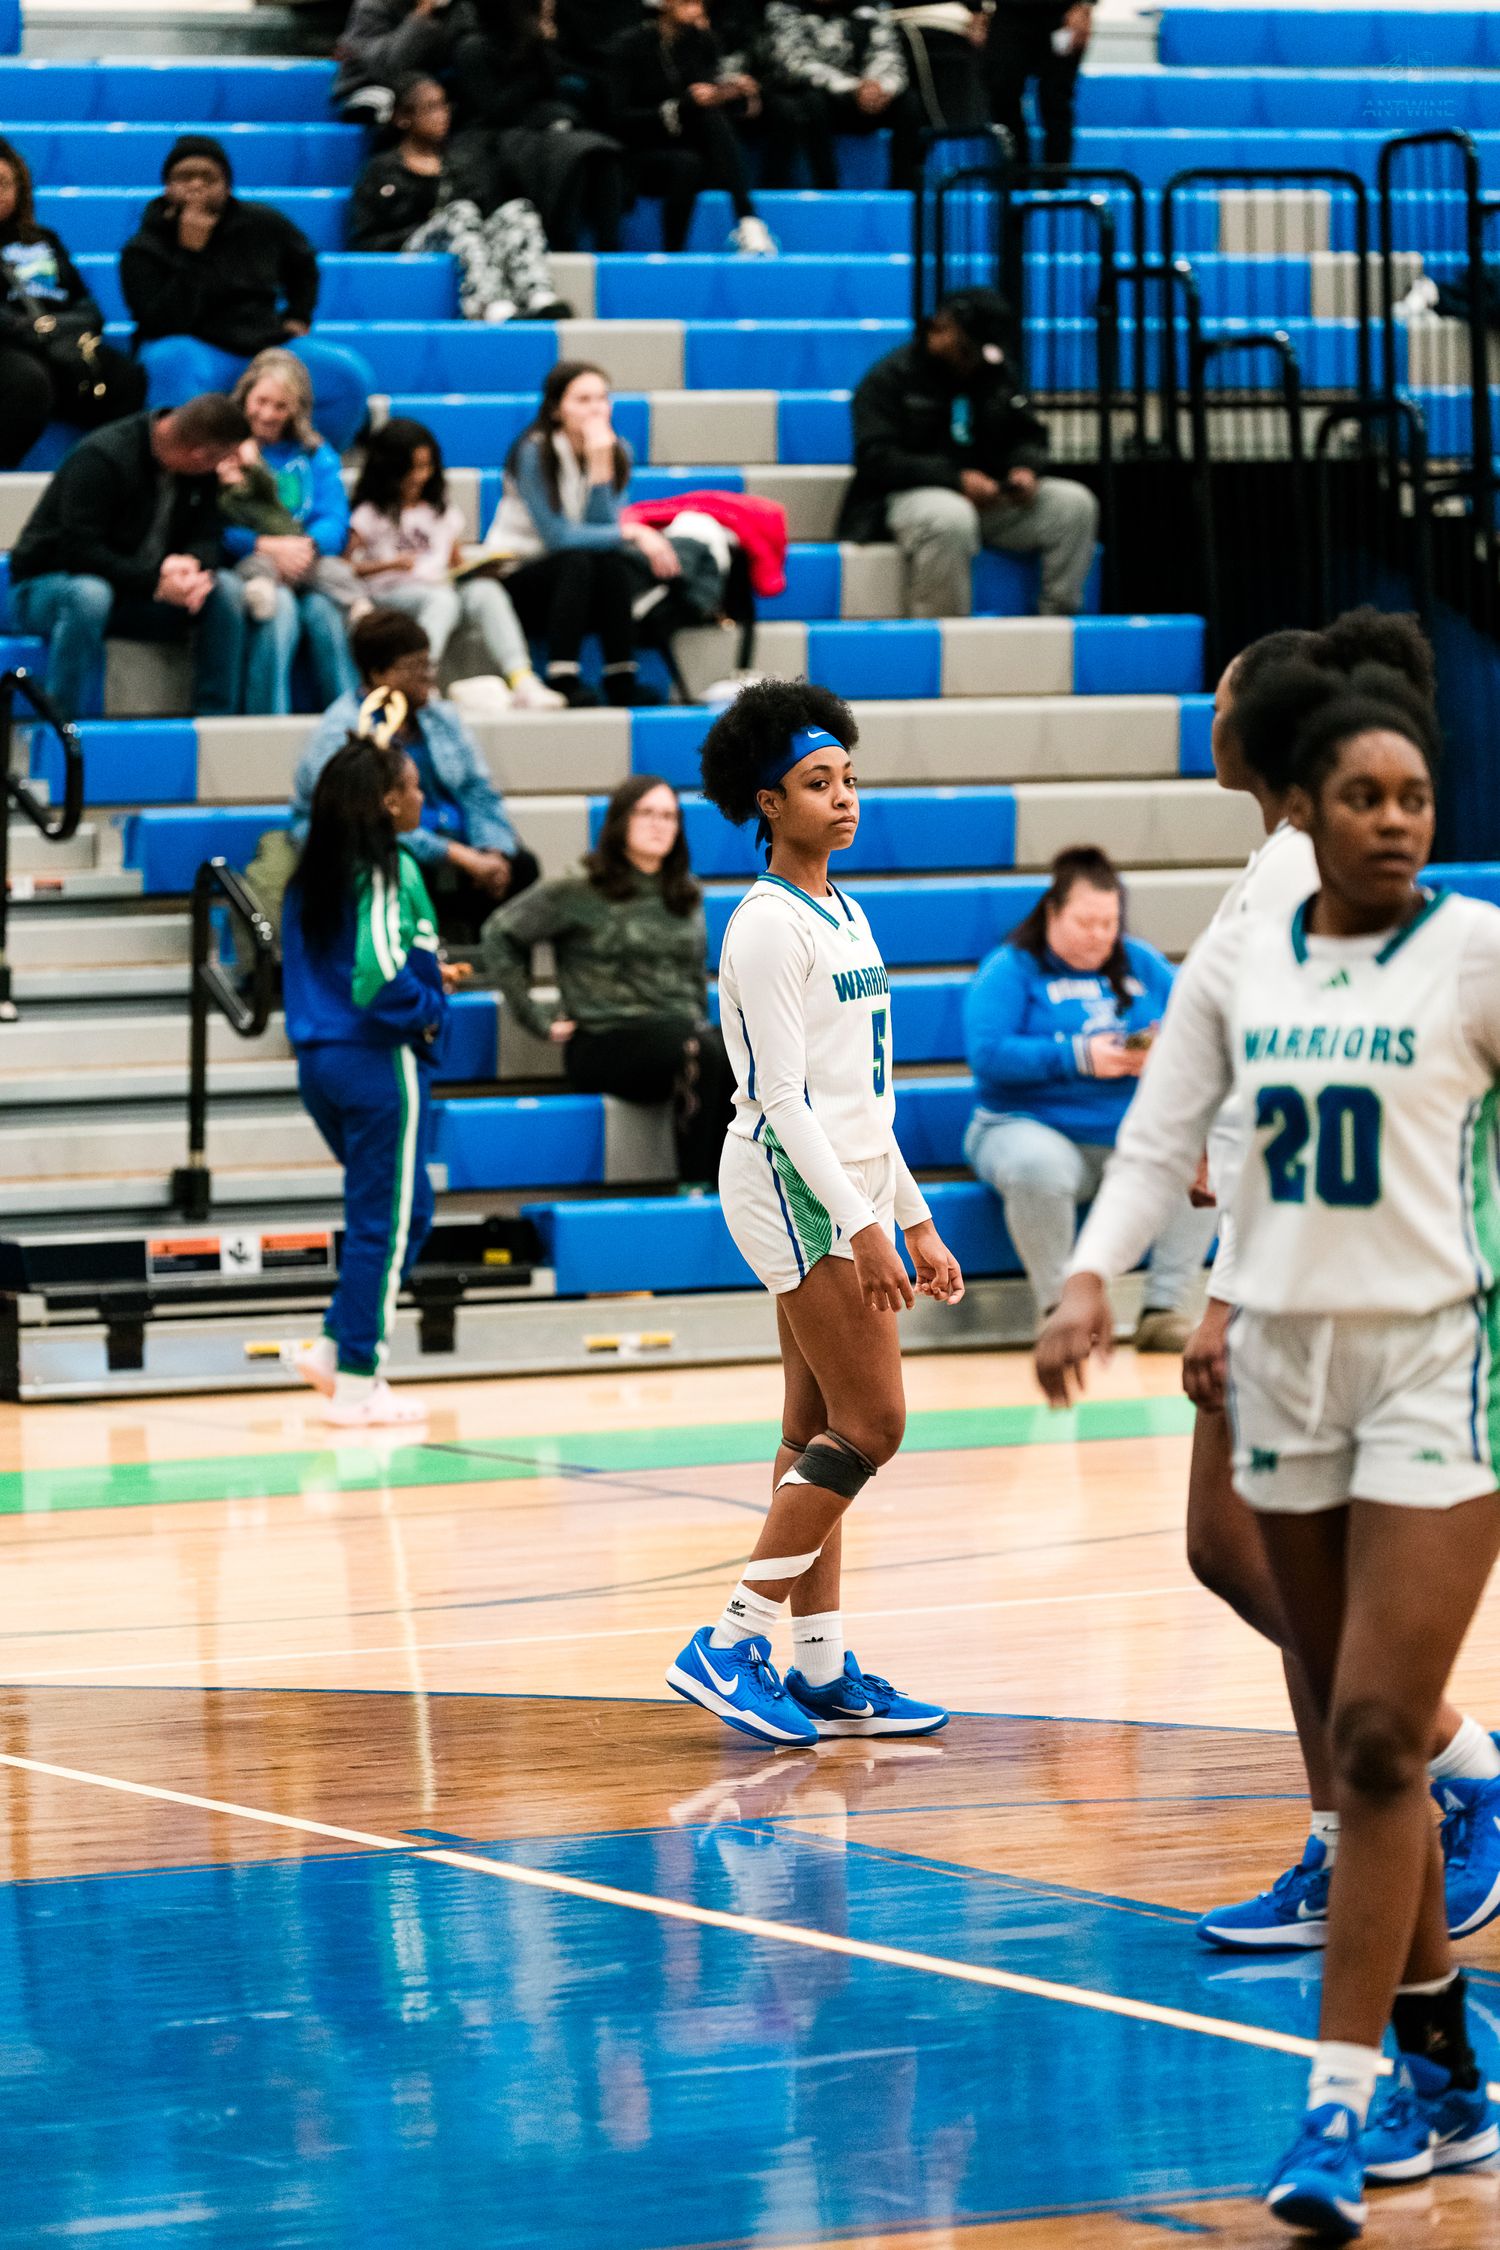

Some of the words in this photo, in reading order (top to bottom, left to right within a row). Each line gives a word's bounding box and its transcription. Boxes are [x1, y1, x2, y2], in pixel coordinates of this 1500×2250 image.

[871, 1008, 887, 1098] 5
[1244, 1025, 1416, 1067] WARRIORS
[1256, 1085, 1382, 1208] 20
